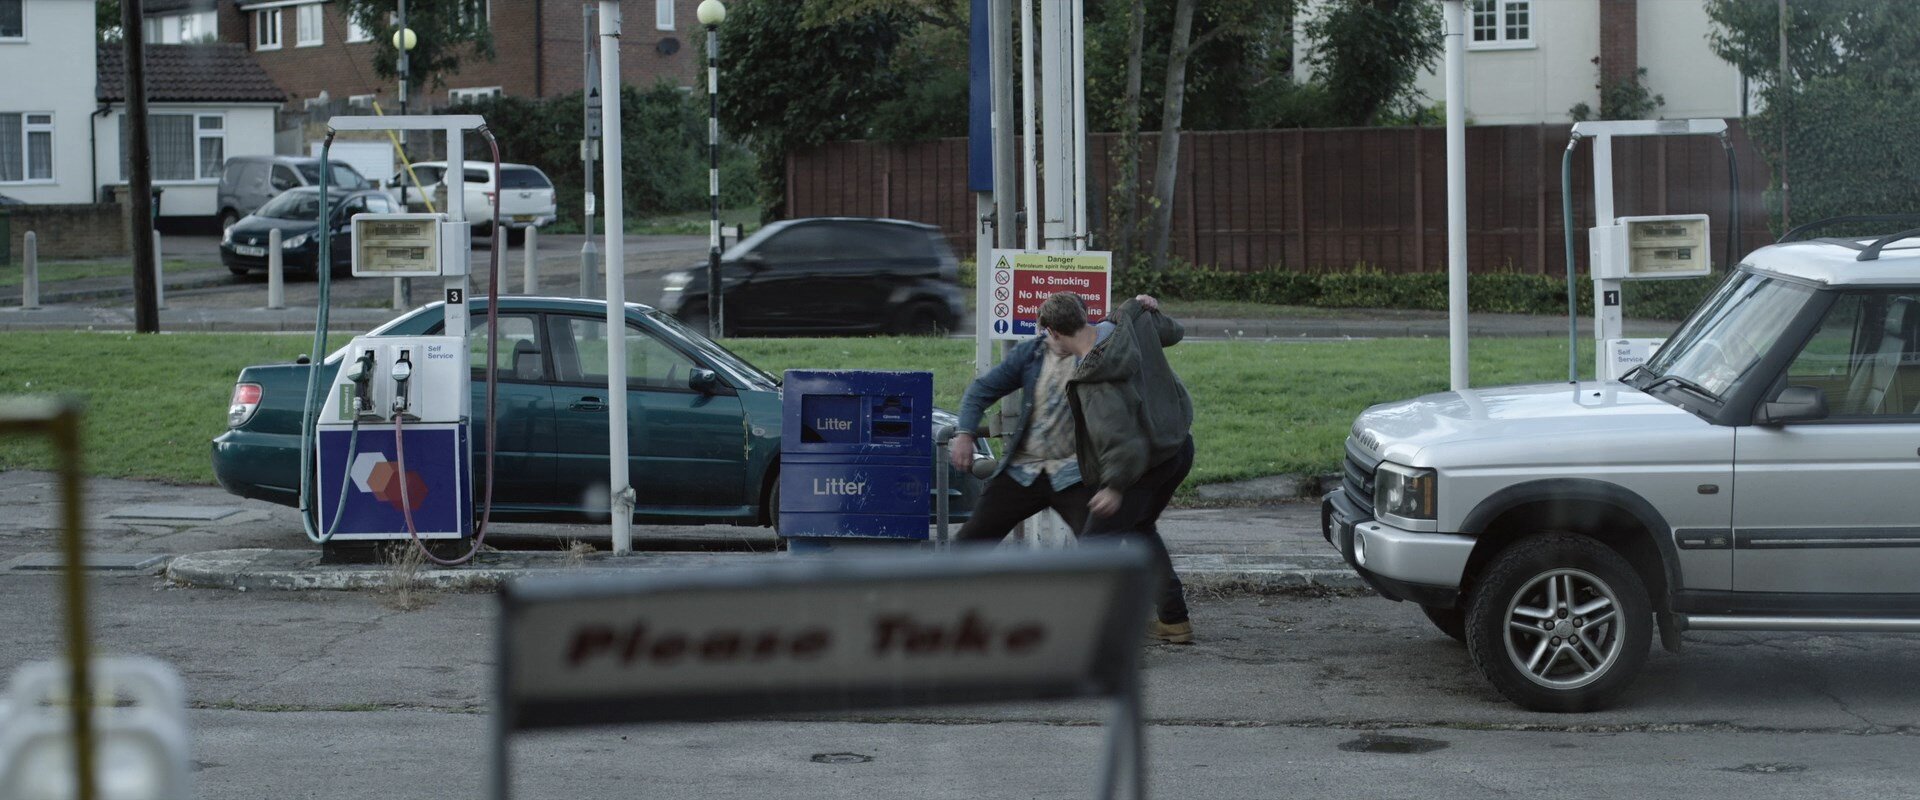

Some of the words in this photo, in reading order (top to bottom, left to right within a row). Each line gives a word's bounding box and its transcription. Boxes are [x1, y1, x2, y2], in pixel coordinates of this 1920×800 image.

[1047, 256, 1074, 264] Danger
[1031, 275, 1045, 285] No
[1047, 276, 1090, 287] Smoking
[451, 291, 458, 302] 3
[1018, 290, 1032, 299] No
[1035, 291, 1053, 300] Nak
[1608, 293, 1615, 304] 1
[1017, 304, 1038, 314] Swit
[1020, 320, 1037, 328] Repo
[816, 418, 853, 430] Litter
[813, 478, 865, 495] Litter
[564, 618, 829, 668] Please
[870, 608, 1046, 657] Take
